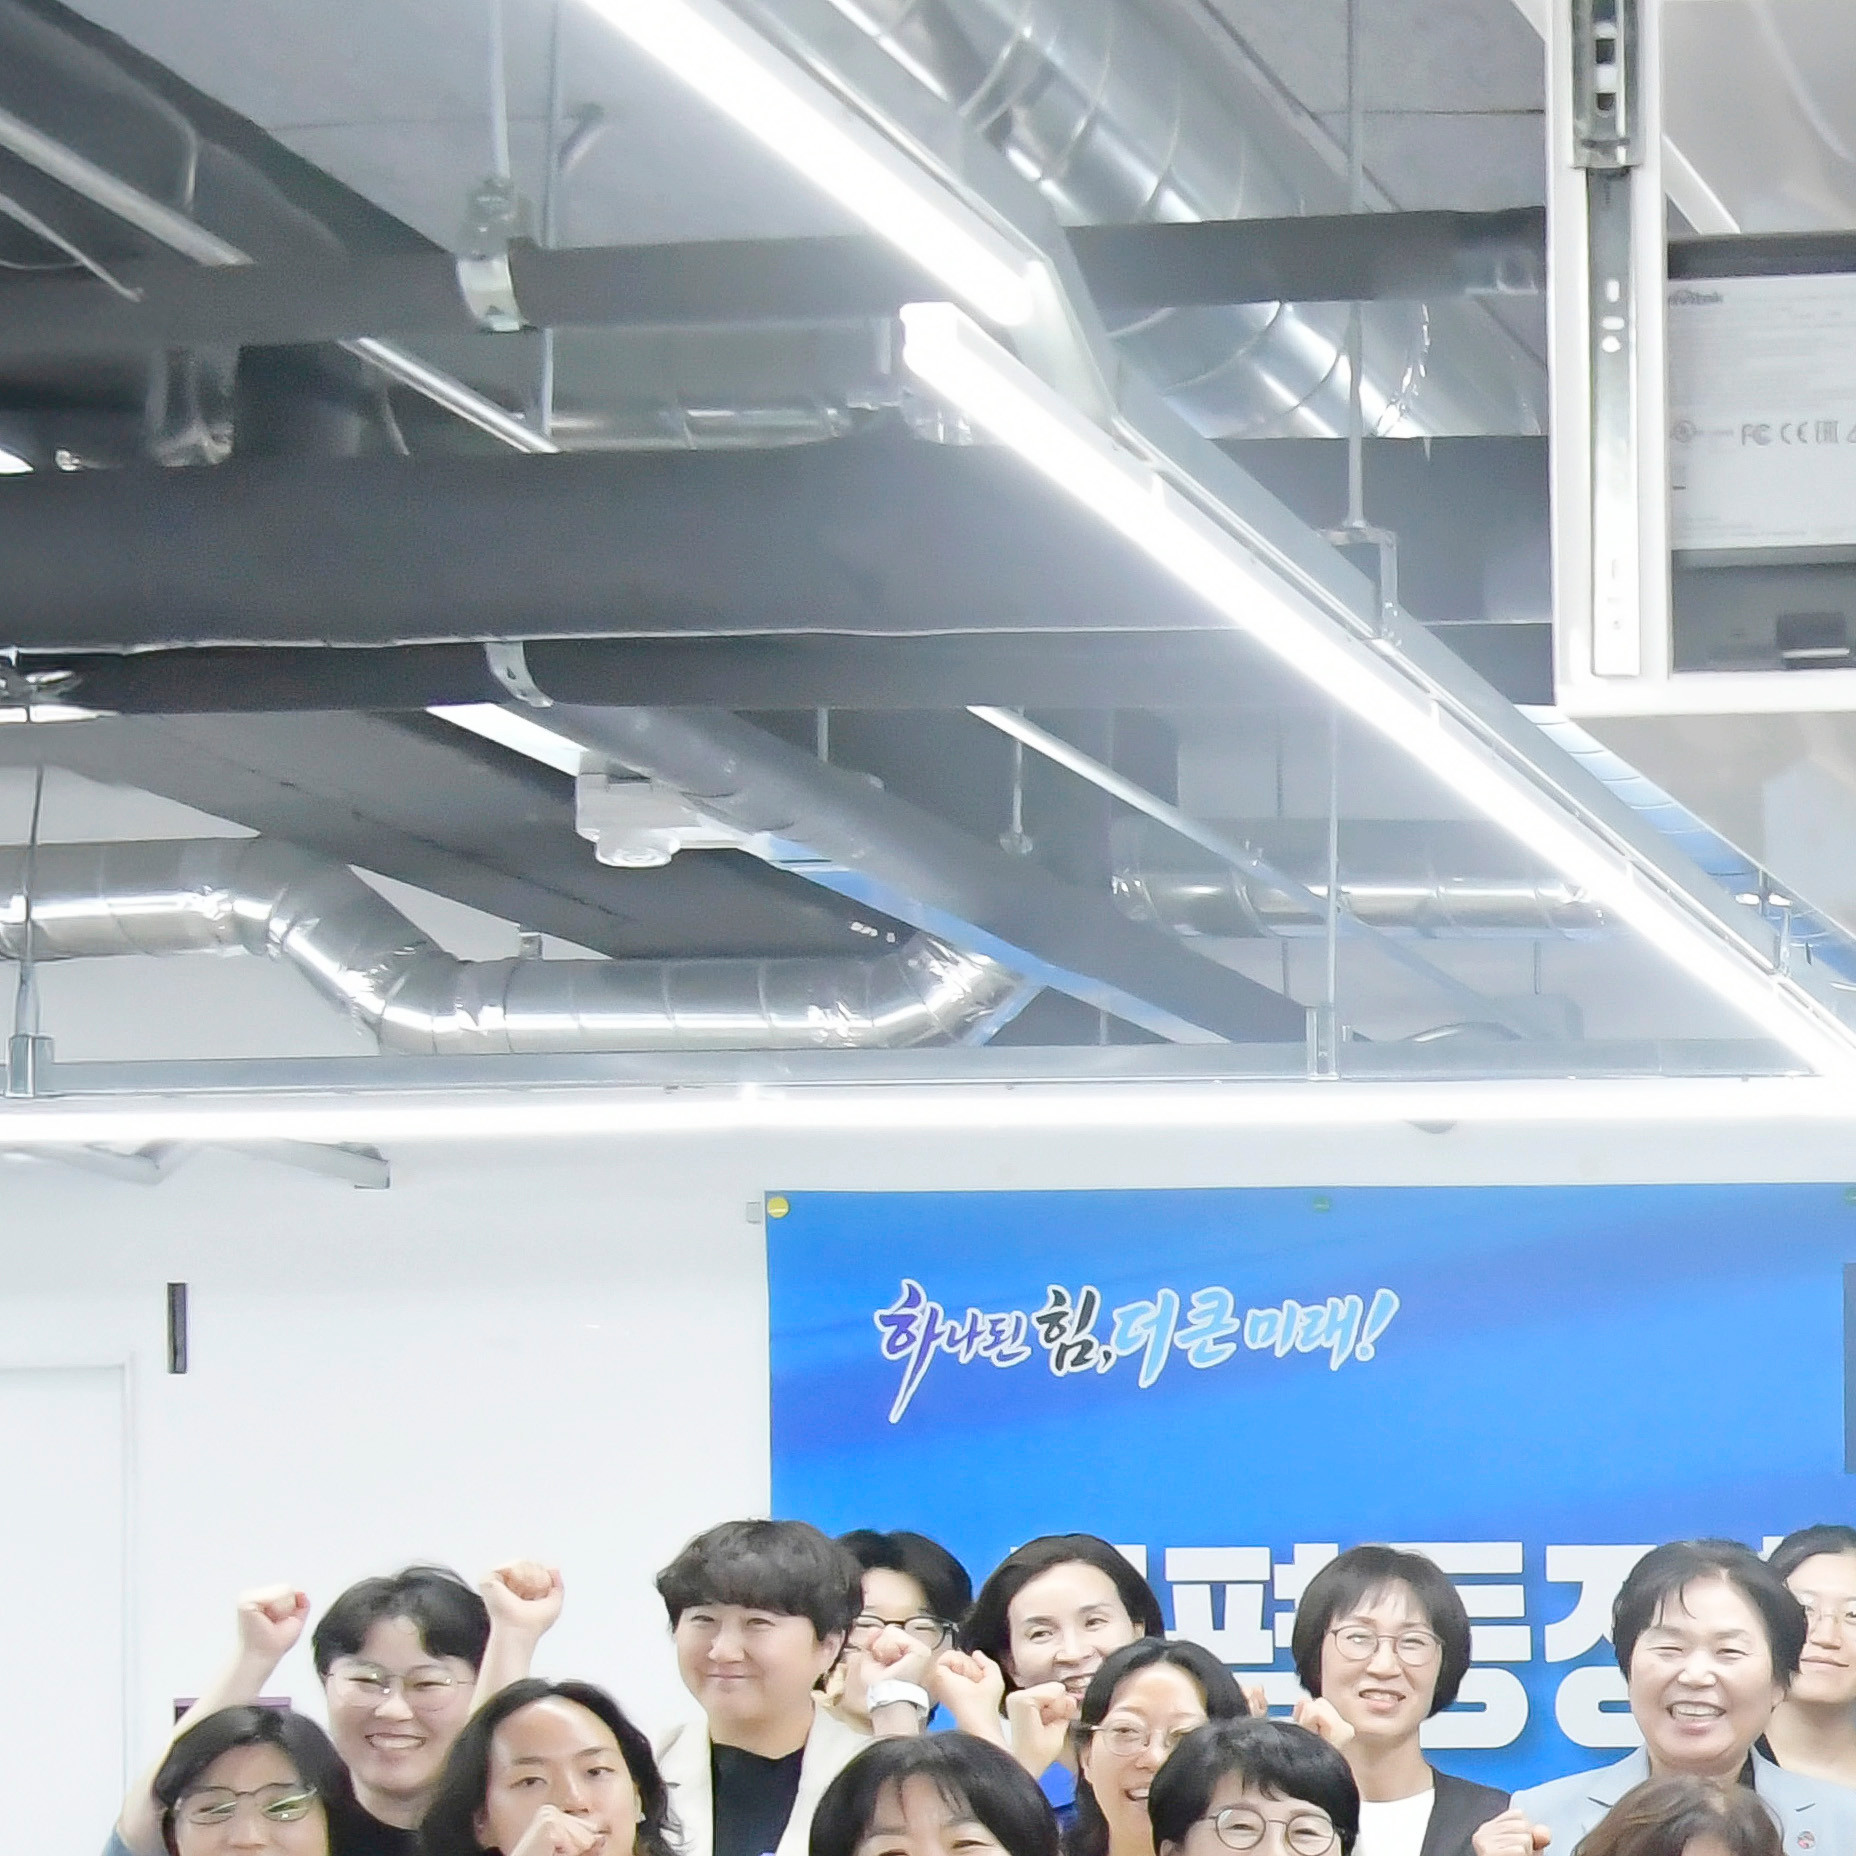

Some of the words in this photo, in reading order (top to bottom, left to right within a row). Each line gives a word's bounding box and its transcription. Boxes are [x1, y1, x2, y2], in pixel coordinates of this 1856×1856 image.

[875, 1279, 1032, 1423] 하나된
[1113, 1287, 1180, 1388] 더
[1174, 1285, 1241, 1368] 큰
[1244, 1287, 1401, 1371] 미래!
